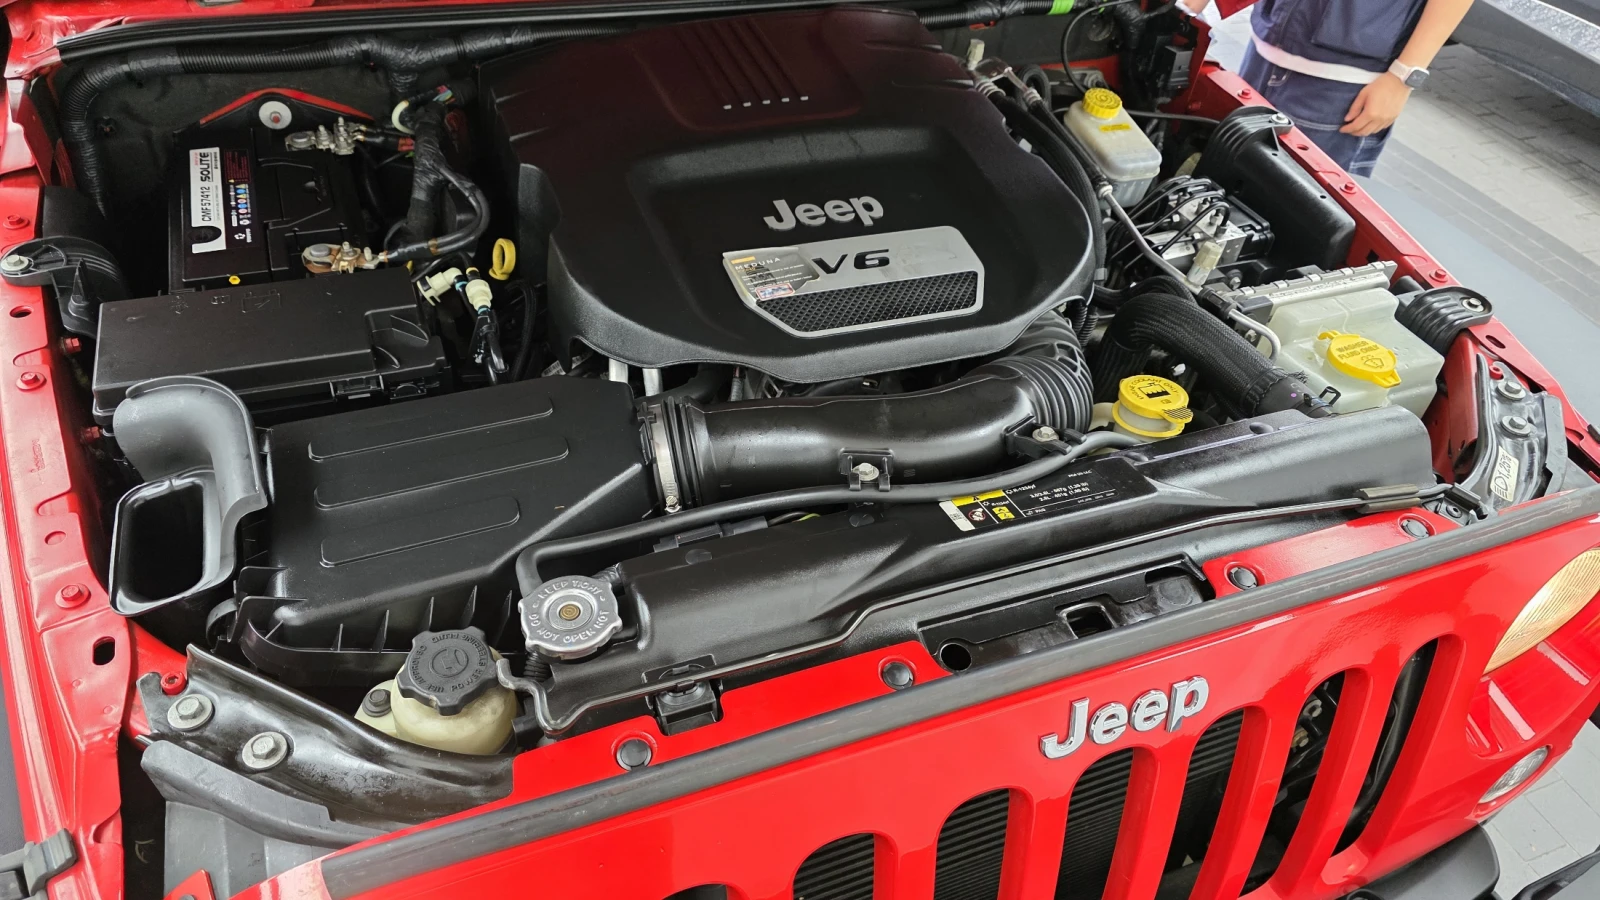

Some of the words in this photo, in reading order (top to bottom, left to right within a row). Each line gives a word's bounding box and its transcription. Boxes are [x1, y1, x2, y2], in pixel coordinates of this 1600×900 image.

[199, 152, 211, 182] SOLITE
[762, 195, 884, 231] Jeep
[811, 248, 890, 275] V6
[1335, 340, 1370, 353] WASHER
[1337, 350, 1361, 360] FLUID
[1360, 344, 1380, 355] ONLY
[538, 580, 569, 599] KEEP
[536, 628, 560, 642] NOT
[563, 627, 597, 644] OPEN
[593, 610, 610, 629] HOT
[451, 668, 482, 692] POWER
[1040, 674, 1210, 759] Jeep
